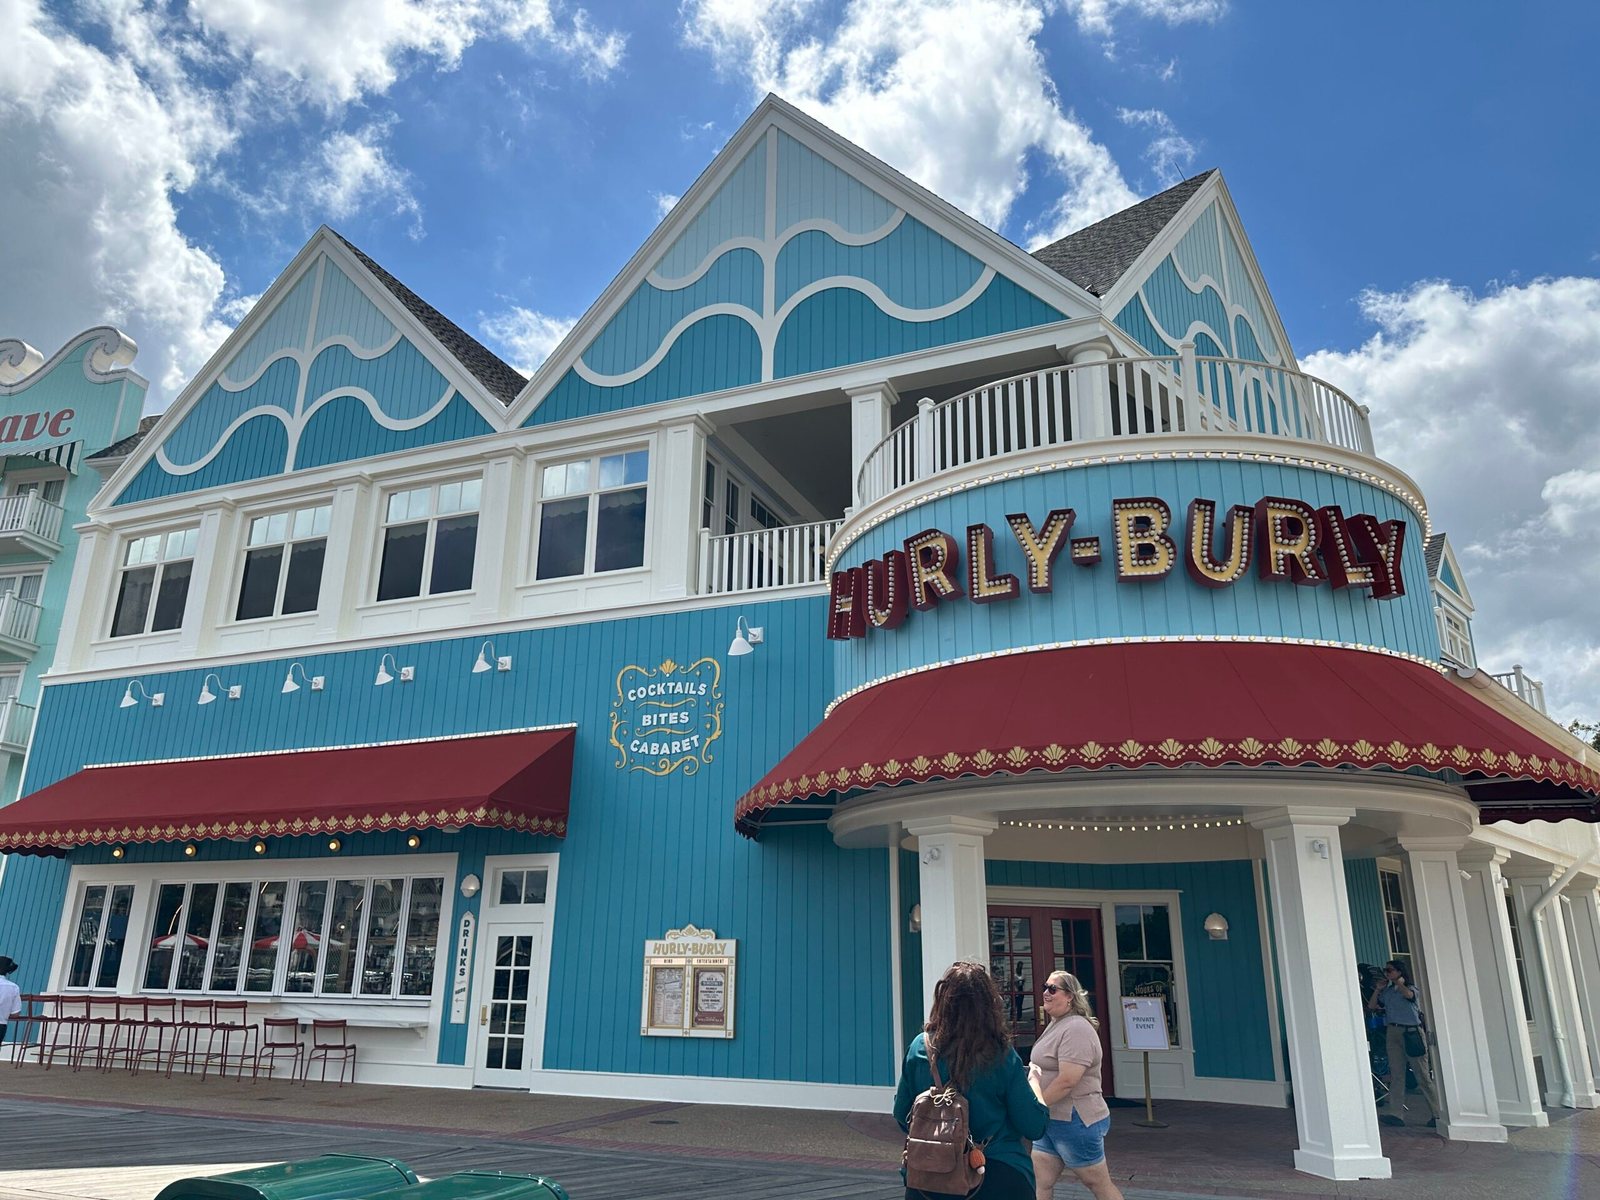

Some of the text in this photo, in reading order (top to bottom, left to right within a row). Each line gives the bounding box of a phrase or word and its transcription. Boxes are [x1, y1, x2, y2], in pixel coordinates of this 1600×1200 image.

[828, 496, 1407, 640] HURLY-BURLY
[628, 682, 707, 701] COCKTAILS
[642, 712, 690, 726] BITES
[630, 735, 700, 755] CABARET
[459, 919, 471, 977] DRINKS
[653, 942, 727, 955] HURLY-BURLY
